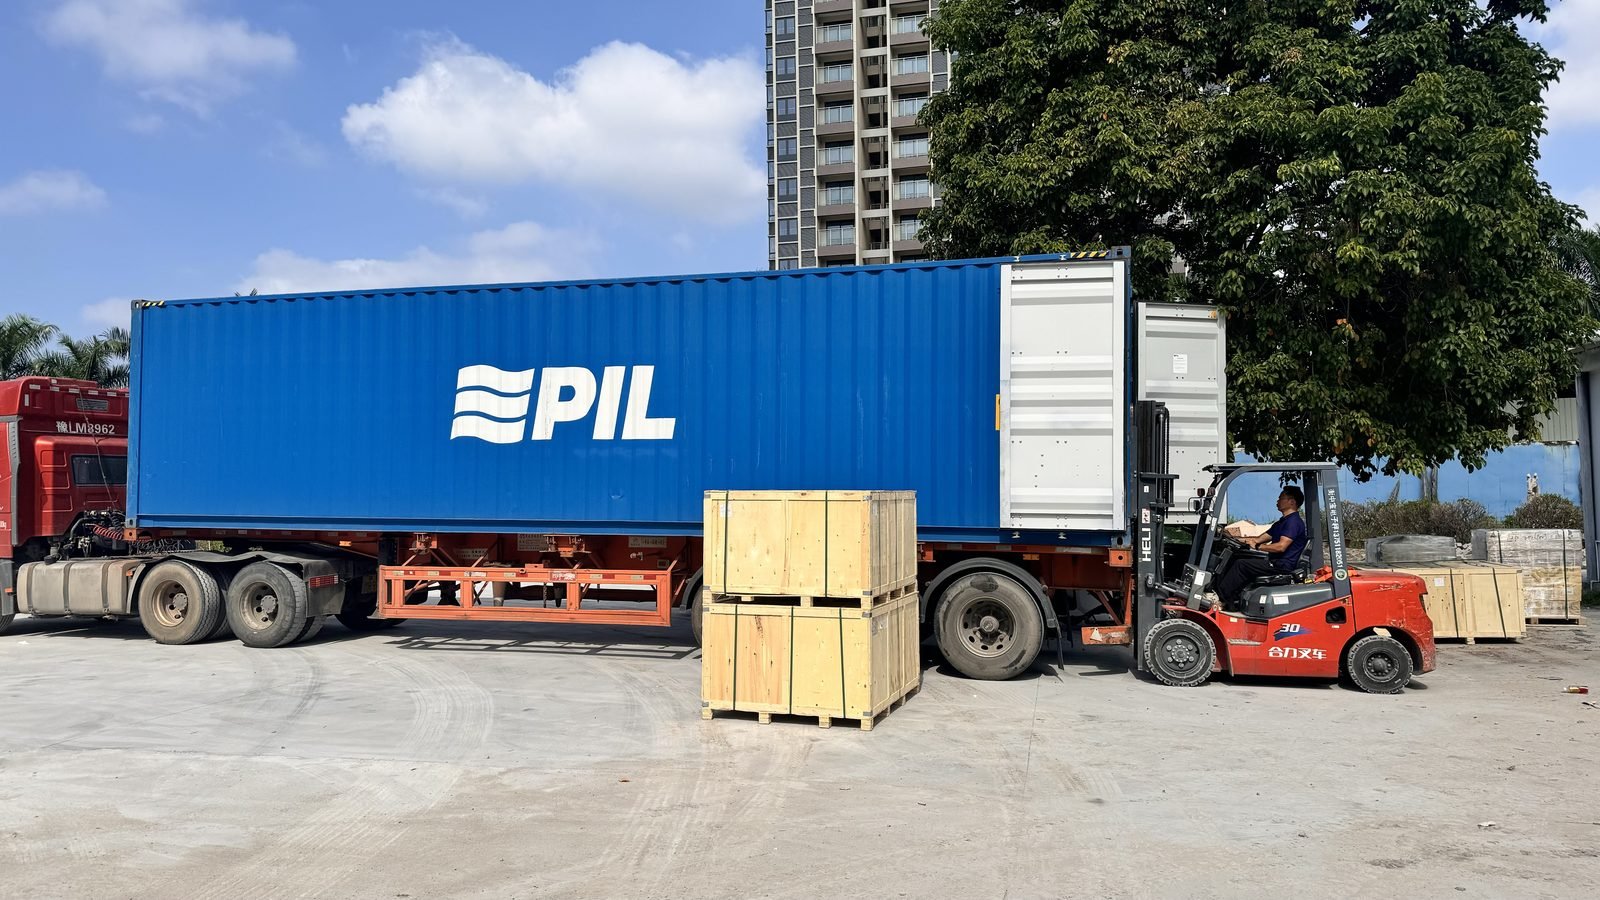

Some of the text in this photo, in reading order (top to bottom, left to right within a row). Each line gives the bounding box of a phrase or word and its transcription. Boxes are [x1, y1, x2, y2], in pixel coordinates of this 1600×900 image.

[531, 365, 676, 440] PIL
[56, 421, 115, 434] 豫LM8962
[1142, 528, 1151, 561] HELI
[1280, 623, 1300, 633] 30
[1268, 646, 1327, 659] 合力叉车
